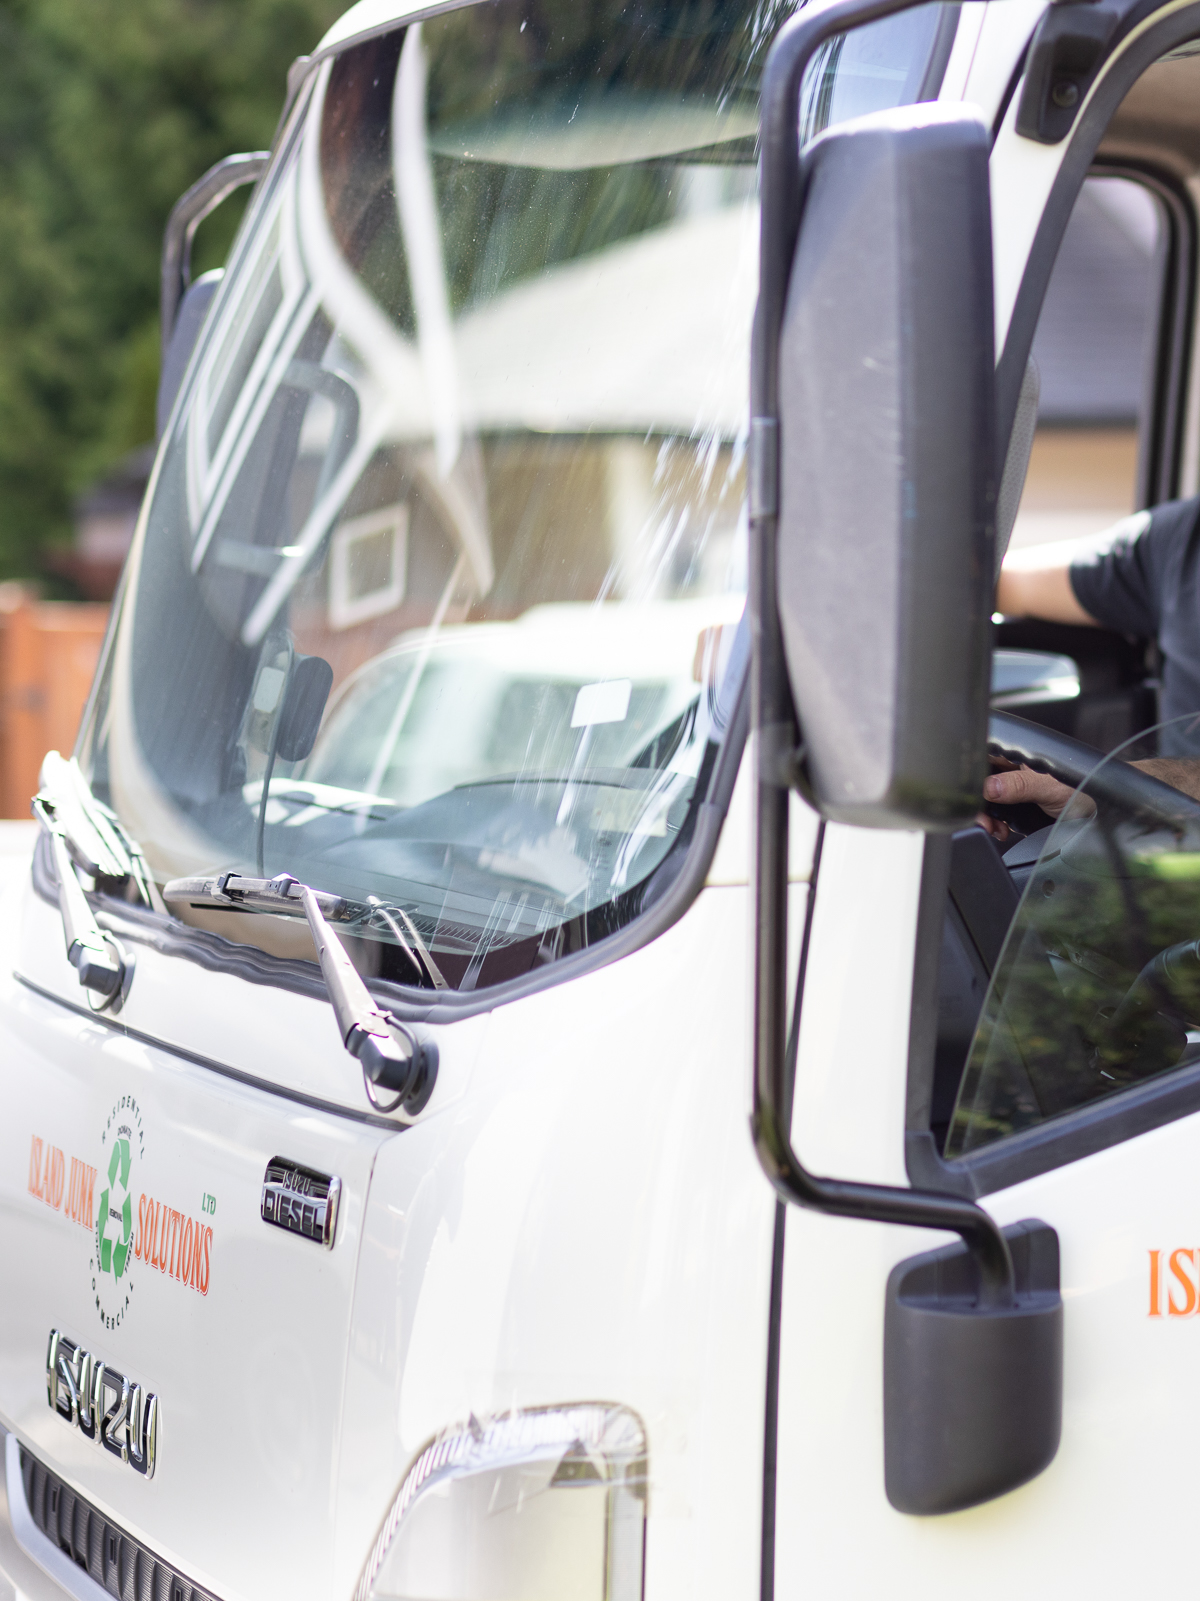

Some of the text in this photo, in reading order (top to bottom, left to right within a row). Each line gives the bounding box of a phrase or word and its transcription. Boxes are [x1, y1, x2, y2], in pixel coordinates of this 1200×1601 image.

[135, 1192, 214, 1297] SOLUTIONS
[201, 1191, 217, 1216] LTD
[47, 1328, 158, 1481] ISUZU
